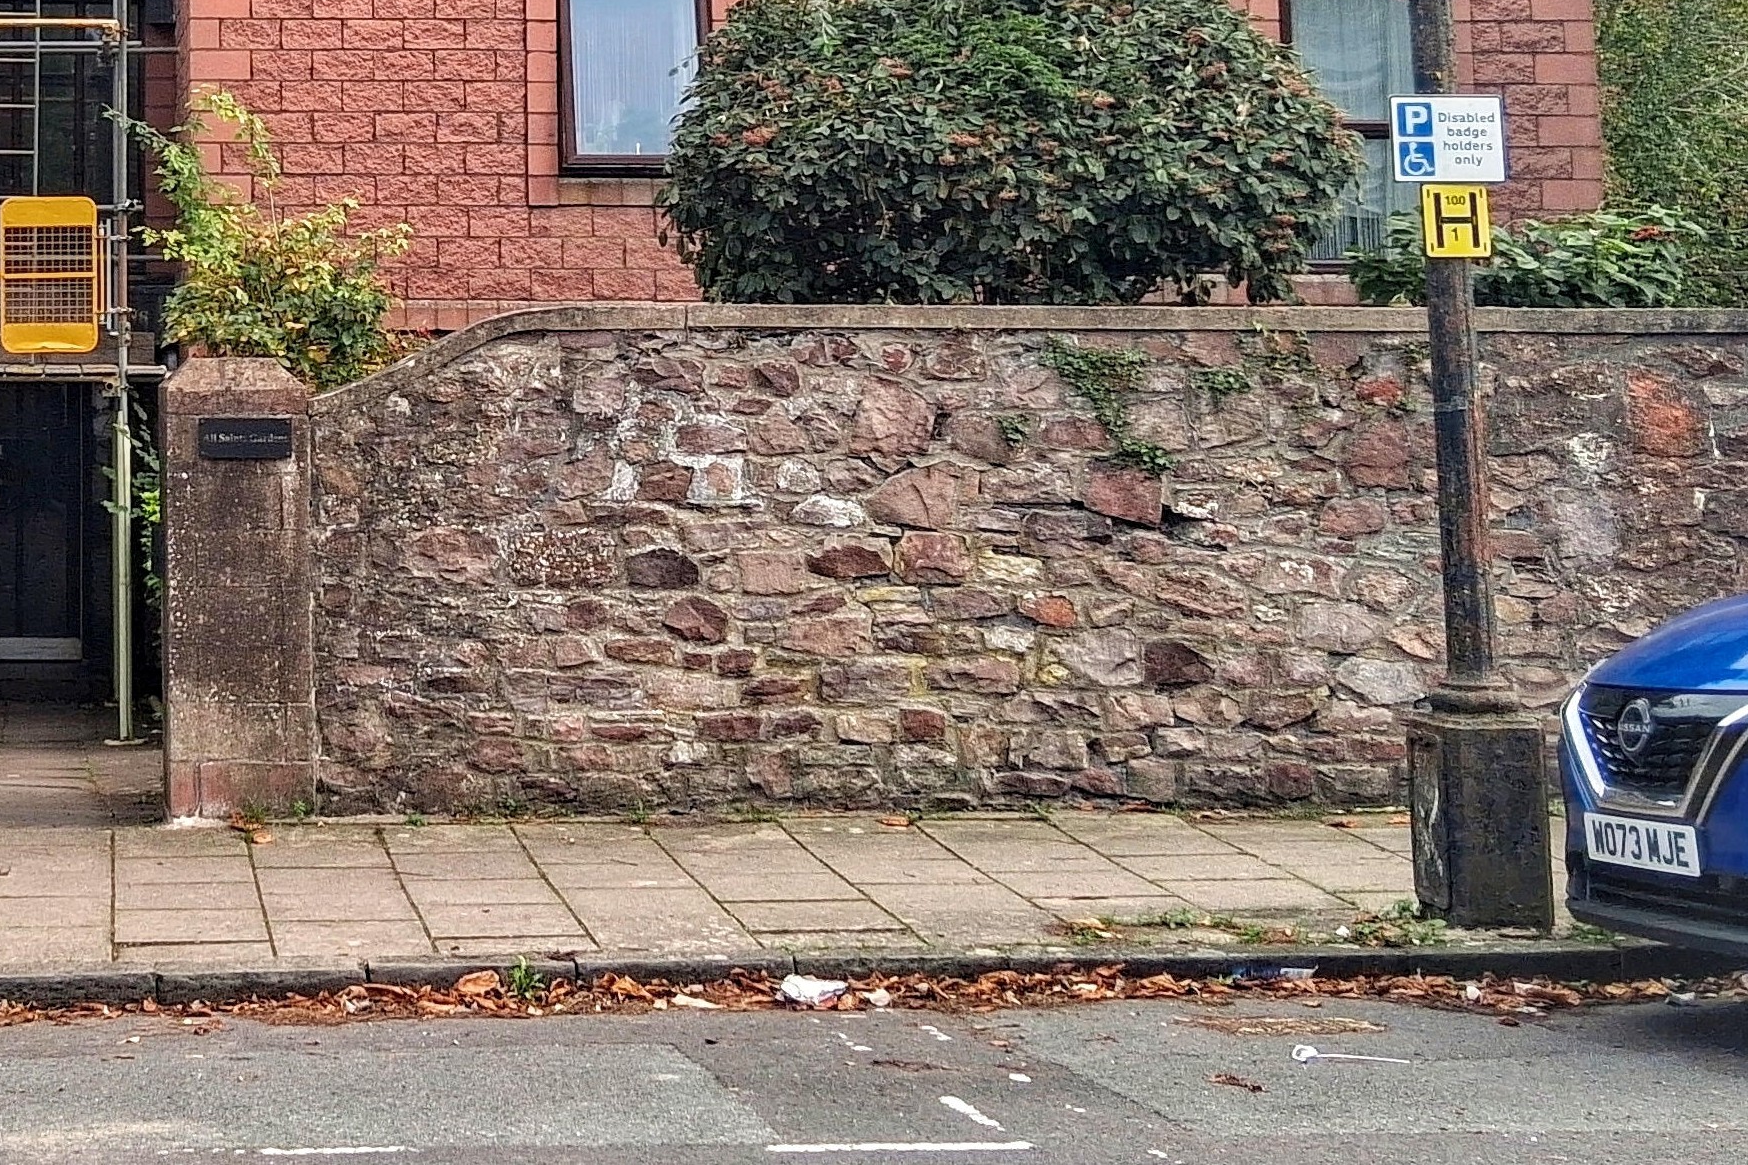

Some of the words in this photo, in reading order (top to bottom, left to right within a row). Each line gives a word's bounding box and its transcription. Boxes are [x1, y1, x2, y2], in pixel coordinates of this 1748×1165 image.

[1404, 105, 1427, 134] P
[1438, 112, 1495, 123] Disabled
[1447, 126, 1488, 138] badge
[1443, 141, 1493, 151] holders
[1455, 154, 1483, 167] only
[1444, 195, 1466, 205] 100
[1433, 192, 1480, 249] H
[1451, 227, 1459, 242] 1
[204, 433, 217, 443] All
